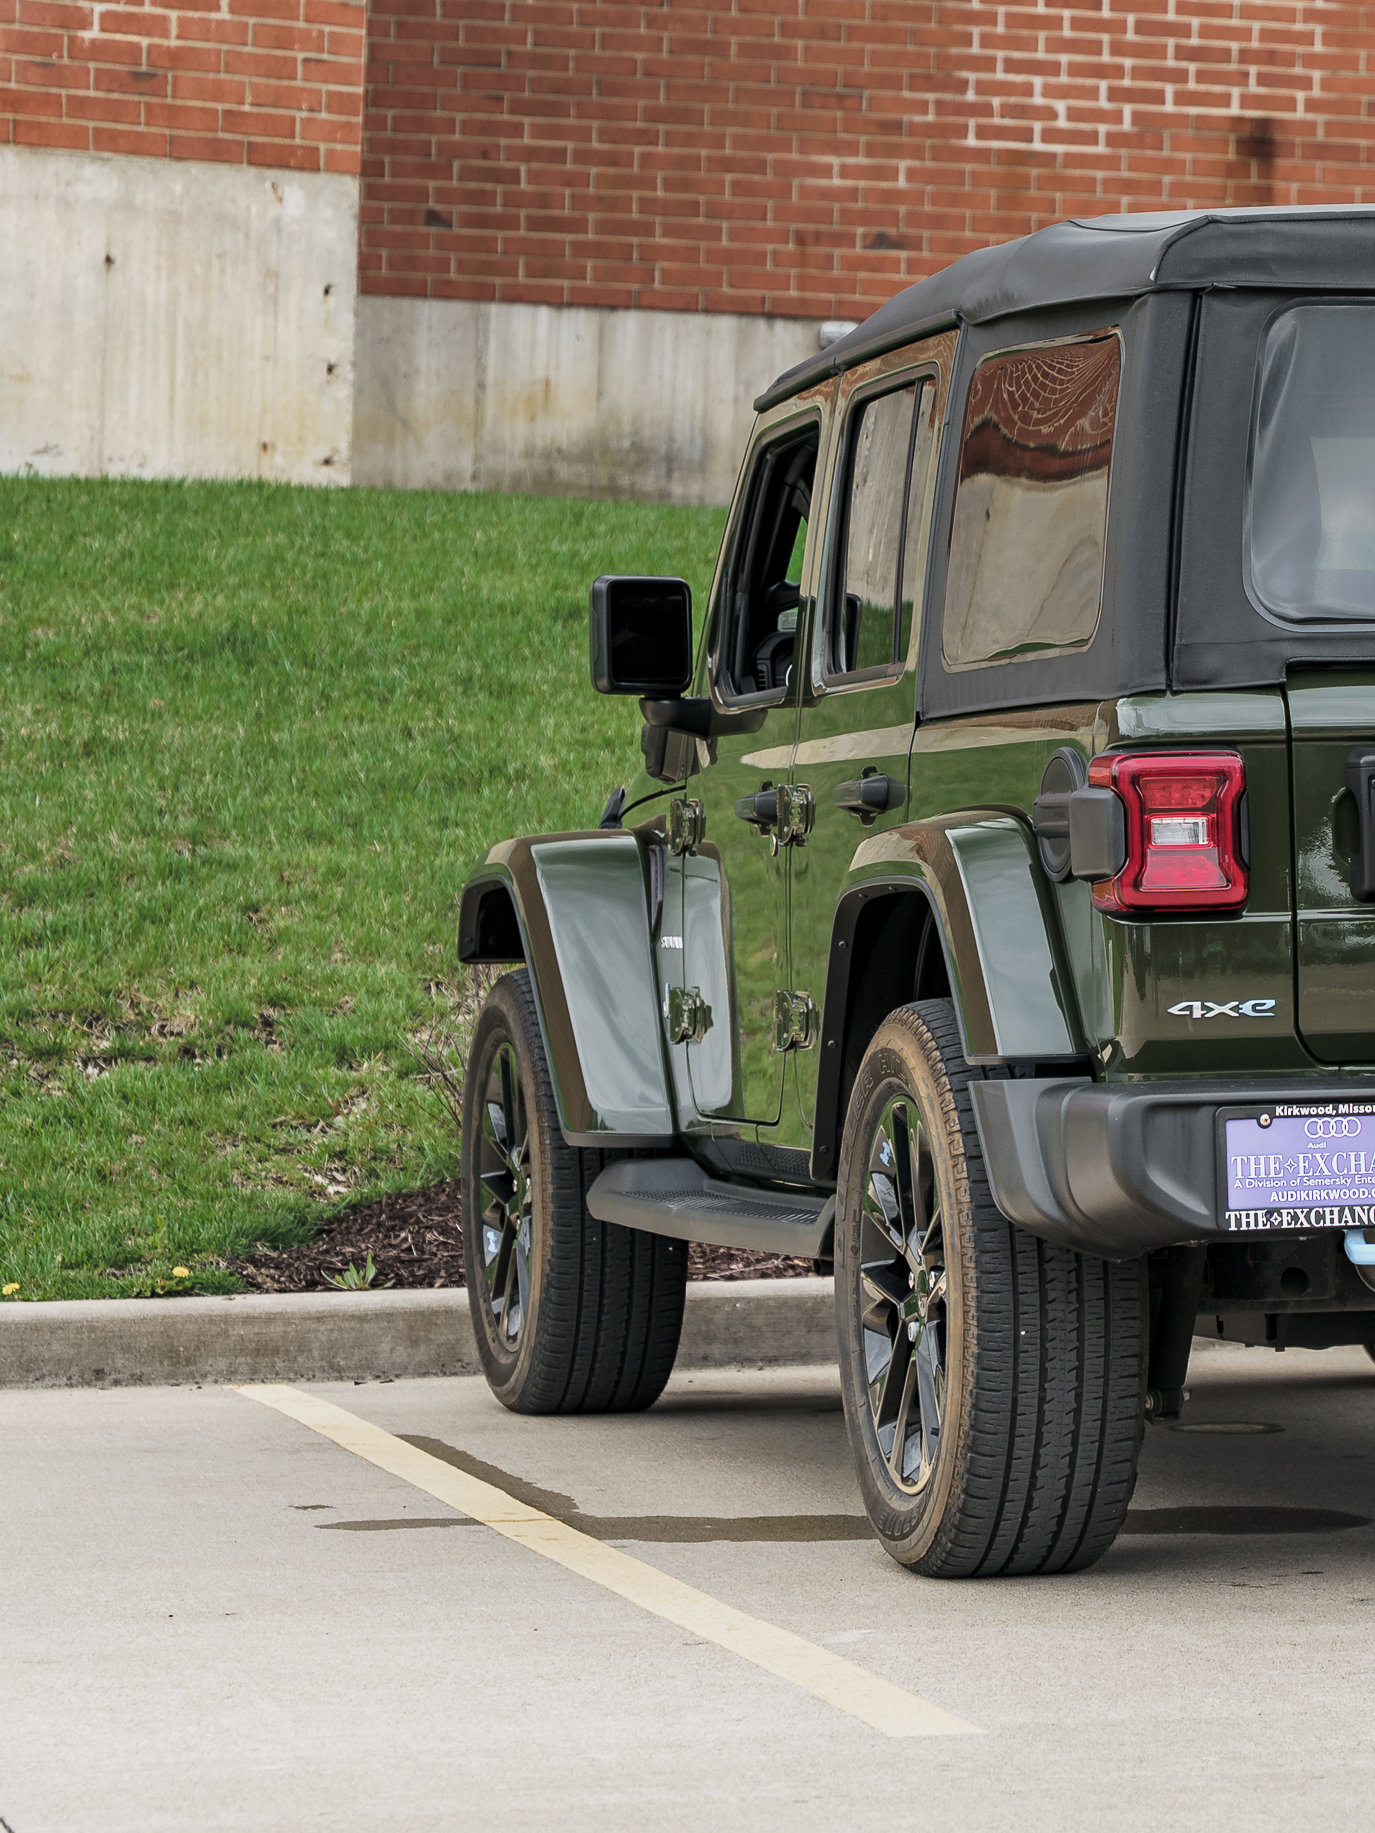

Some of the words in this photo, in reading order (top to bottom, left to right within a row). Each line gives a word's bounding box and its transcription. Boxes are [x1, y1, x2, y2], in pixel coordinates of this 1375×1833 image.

[1275, 1104, 1336, 1116] Kirkwood,
[1231, 1154, 1284, 1179] THE
[1233, 1180, 1243, 1188] A
[1246, 1179, 1287, 1189] Division
[1290, 1177, 1301, 1186] of
[1303, 1175, 1352, 1186] Semersky
[1225, 1209, 1271, 1231] THE
